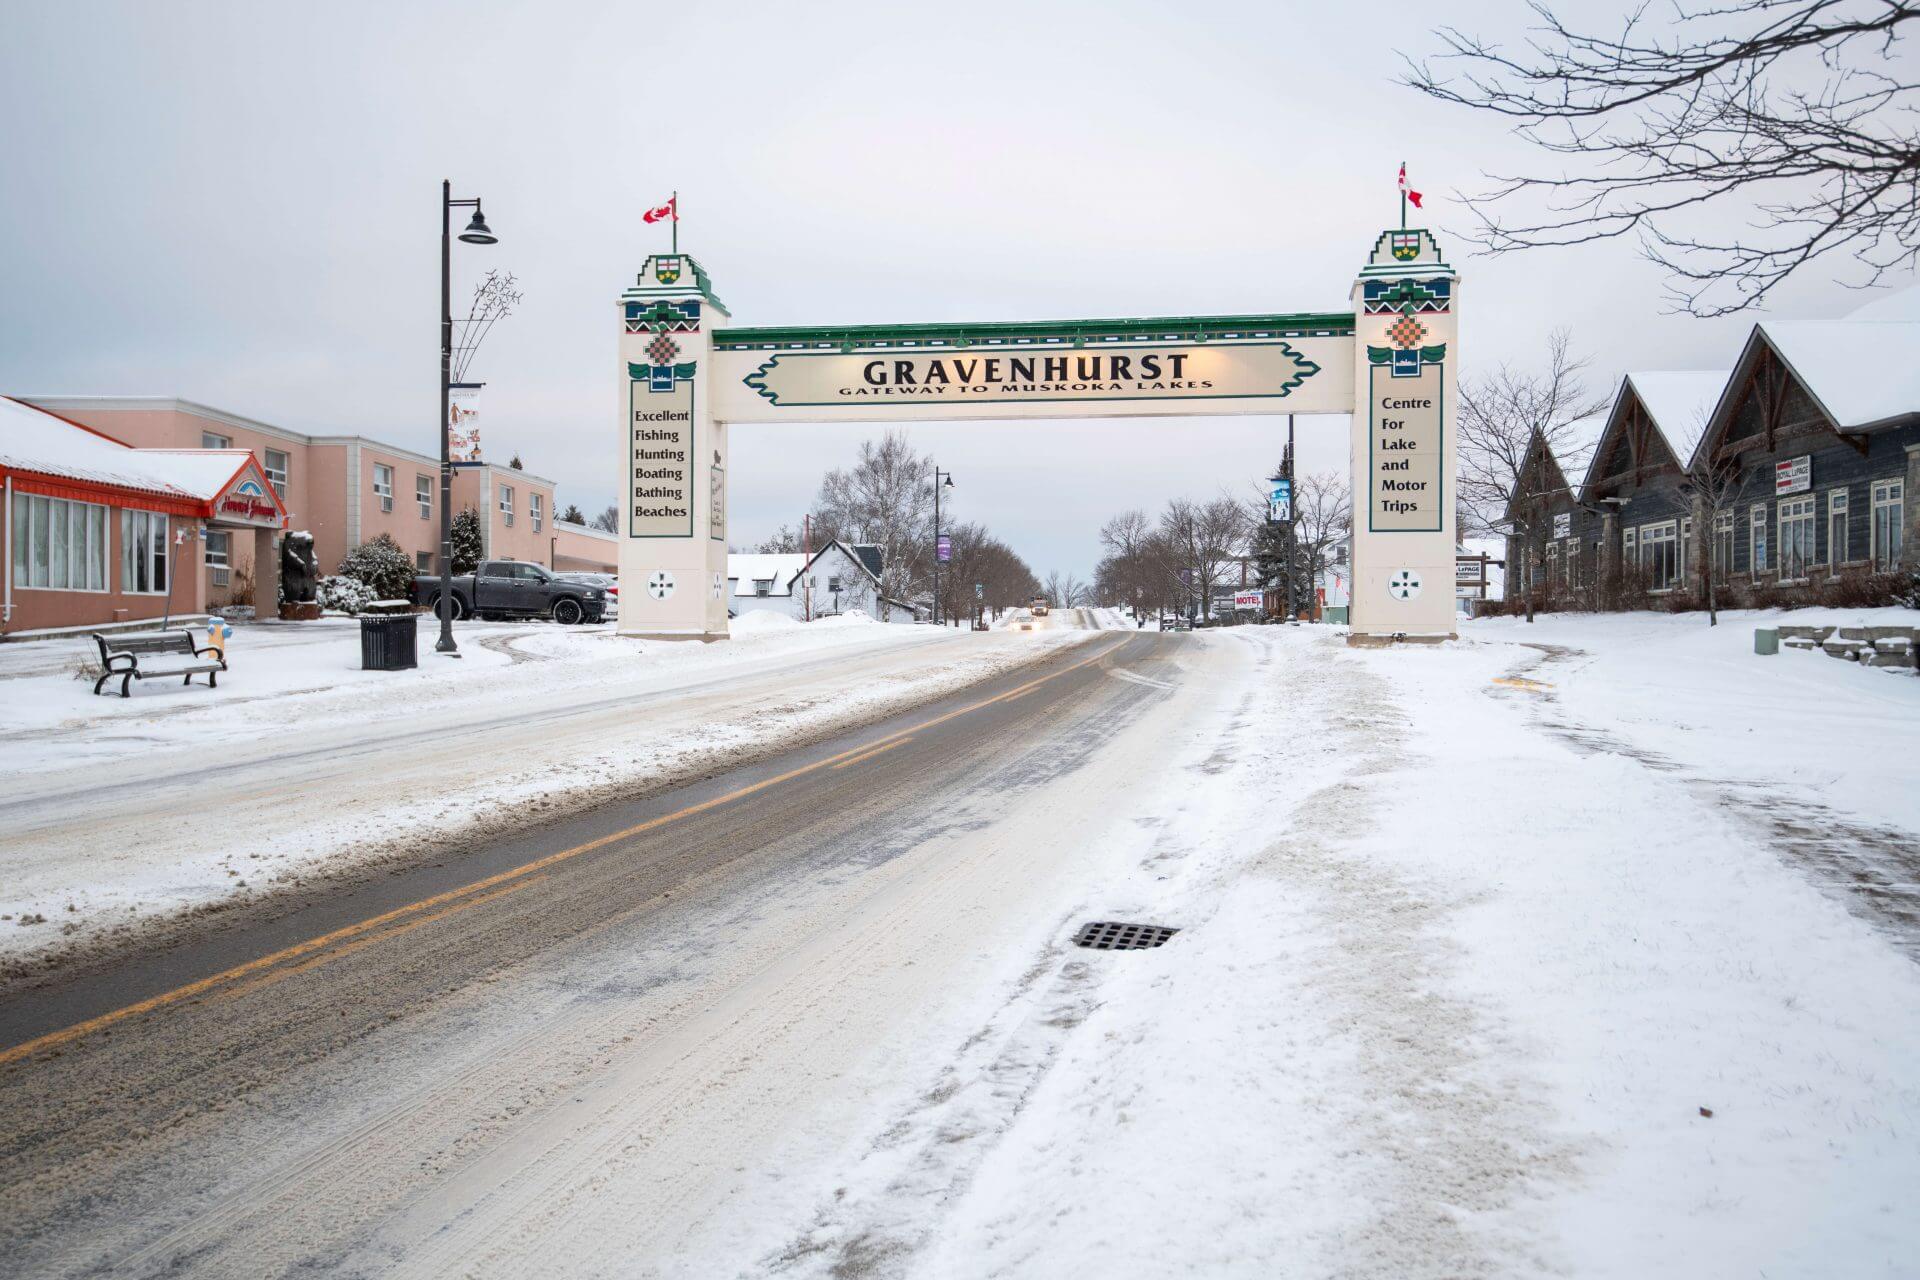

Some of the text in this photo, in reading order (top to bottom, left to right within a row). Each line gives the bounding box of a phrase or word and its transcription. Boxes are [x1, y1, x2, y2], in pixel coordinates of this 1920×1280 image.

[863, 355, 1189, 385] GRAVENHURST
[838, 380, 1214, 396] GATEWAY TO MUSKOKA LAKES
[1382, 397, 1432, 410] Centre
[635, 410, 690, 422] Excellent
[1382, 418, 1405, 430] For
[635, 429, 680, 443] Fishing
[1382, 438, 1417, 450] Lake
[635, 448, 685, 462] Hunting
[1381, 459, 1409, 471] and
[635, 467, 683, 482] Boating
[1381, 479, 1428, 491] Motor
[635, 486, 683, 501] Bathing
[635, 505, 688, 517] Beaches
[1381, 499, 1418, 515] Trips
